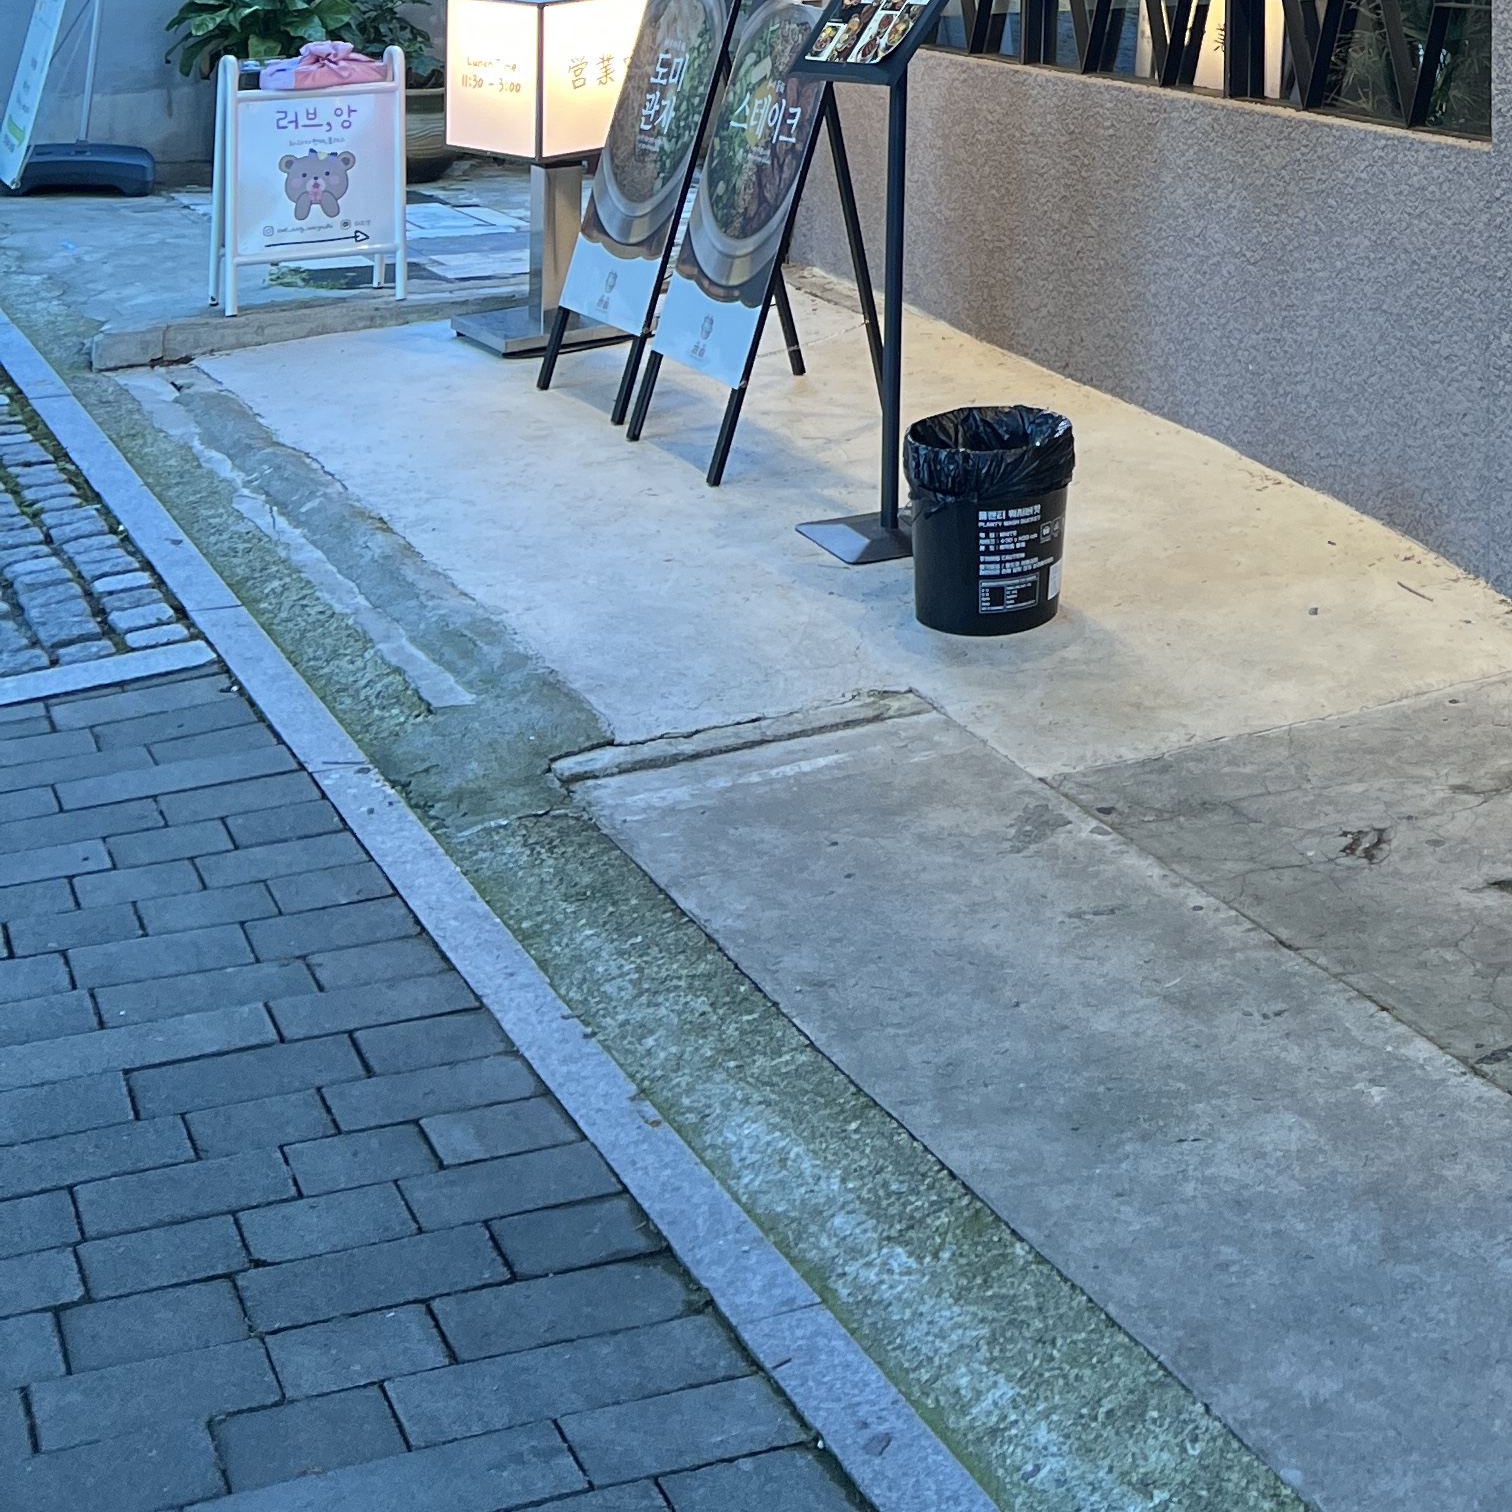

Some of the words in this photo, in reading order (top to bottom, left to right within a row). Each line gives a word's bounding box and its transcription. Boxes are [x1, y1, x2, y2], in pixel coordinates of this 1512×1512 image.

[462, 74, 484, 90] 11:30
[499, 78, 522, 94] 3:00
[568, 54, 632, 90] 営業
[650, 52, 690, 93] 도미
[640, 91, 677, 135] 관자
[729, 92, 802, 145] 스테이크
